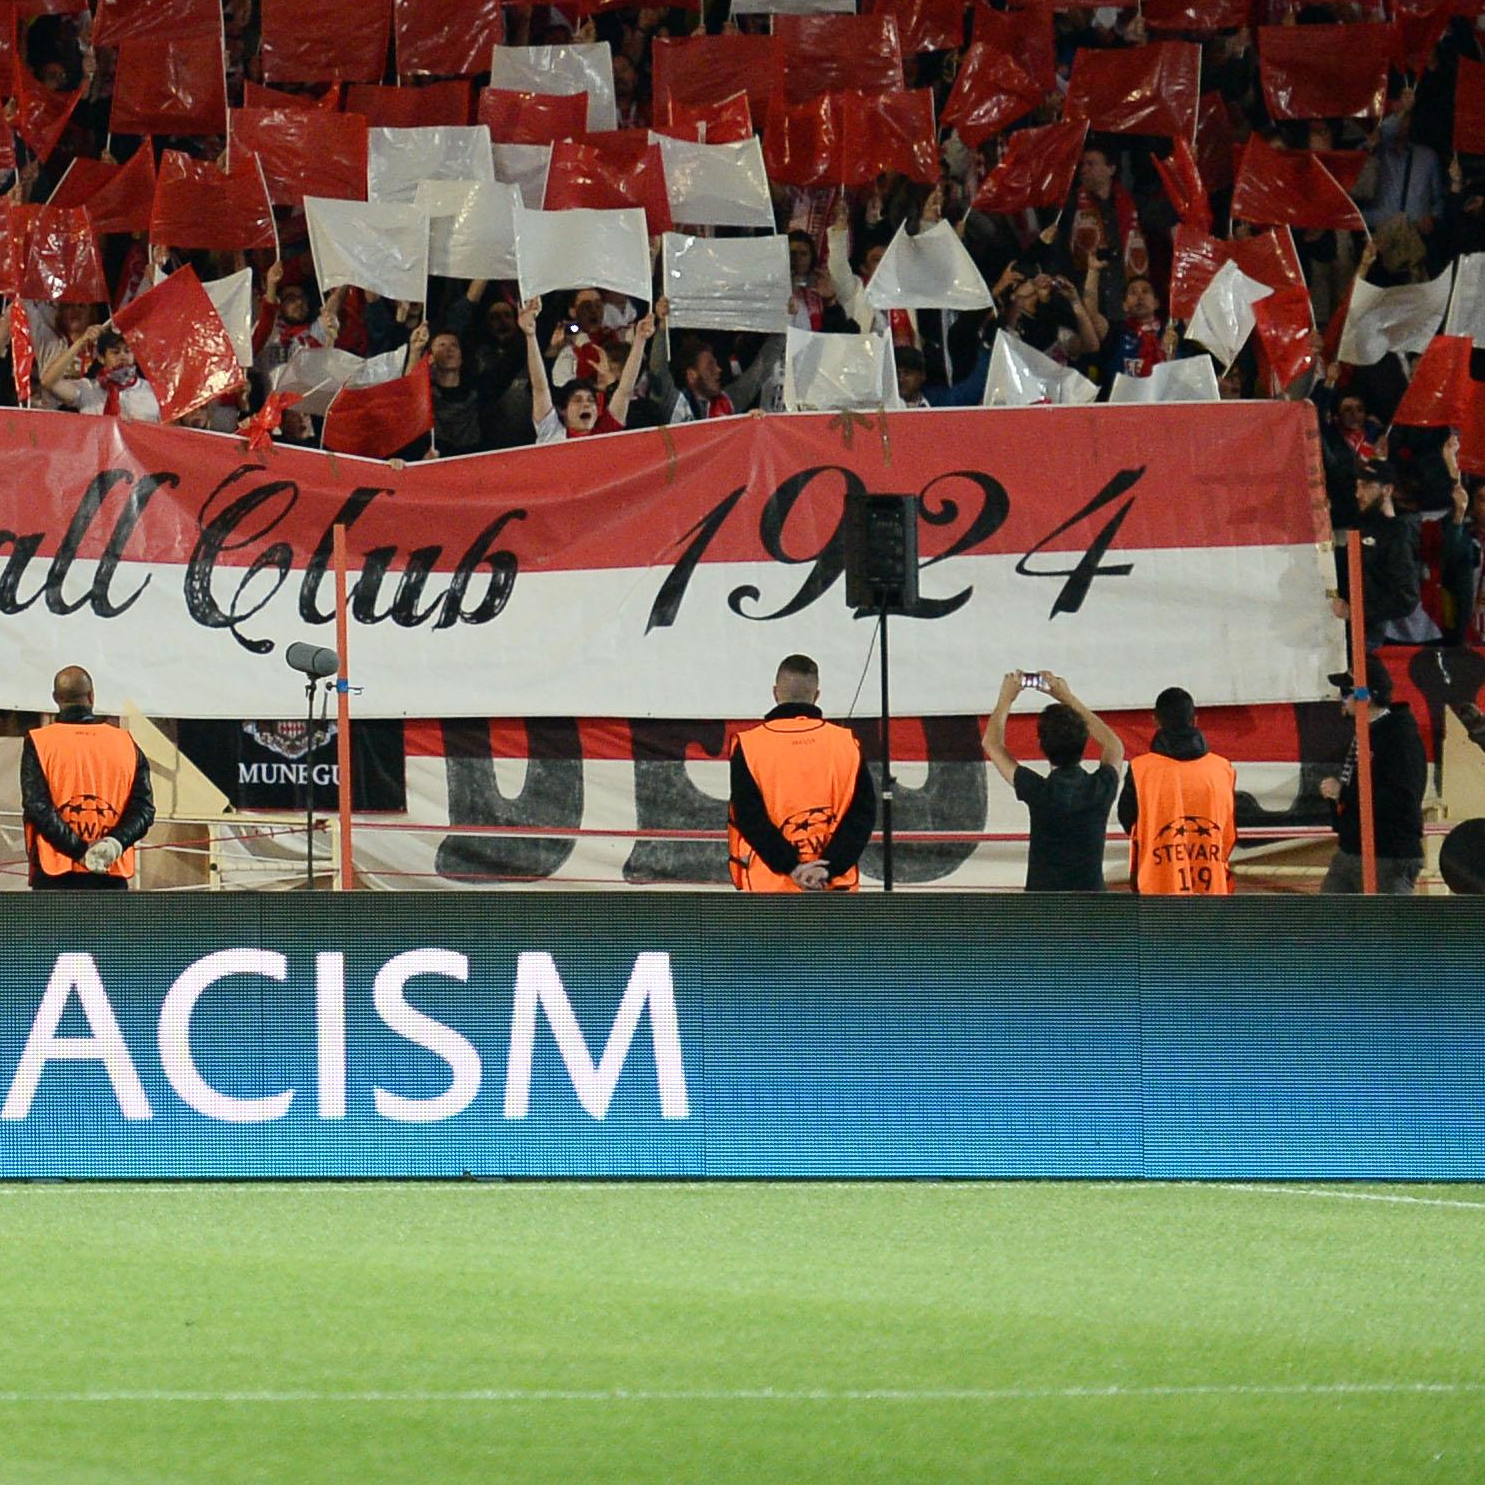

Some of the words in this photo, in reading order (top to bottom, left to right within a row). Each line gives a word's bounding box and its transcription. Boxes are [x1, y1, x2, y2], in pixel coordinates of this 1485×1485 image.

[184, 464, 528, 654] Club
[644, 465, 1146, 637] 1924
[1152, 842, 1223, 865] STEAR
